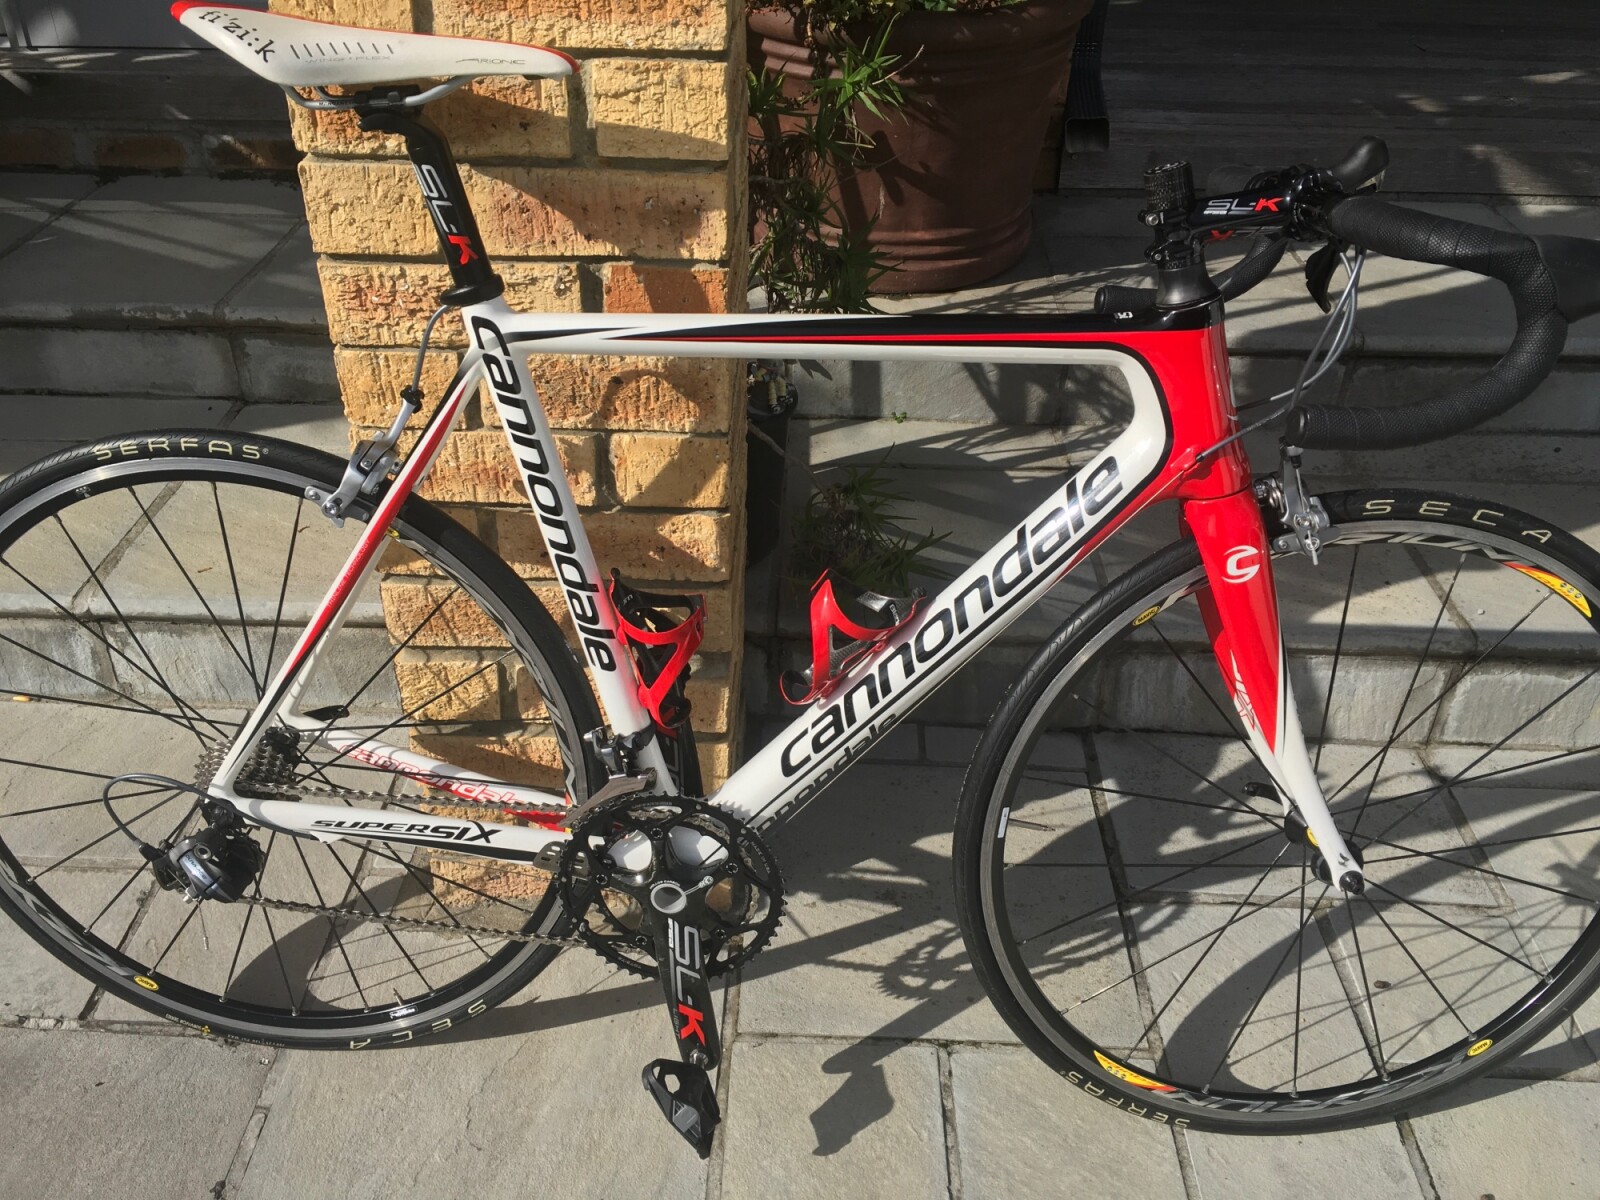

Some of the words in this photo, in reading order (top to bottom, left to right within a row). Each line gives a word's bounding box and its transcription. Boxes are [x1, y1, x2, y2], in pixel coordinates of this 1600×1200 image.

[1205, 197, 1285, 212] SL-K
[94, 437, 262, 462] SERFAS
[471, 315, 617, 673] cannondale
[1362, 499, 1553, 545] SECA
[780, 455, 1124, 778] cannondale
[310, 820, 503, 844] SUPERSIX
[674, 920, 706, 1047] SL-K
[350, 999, 487, 1050] SECA
[1066, 1071, 1191, 1129] SERFAS
